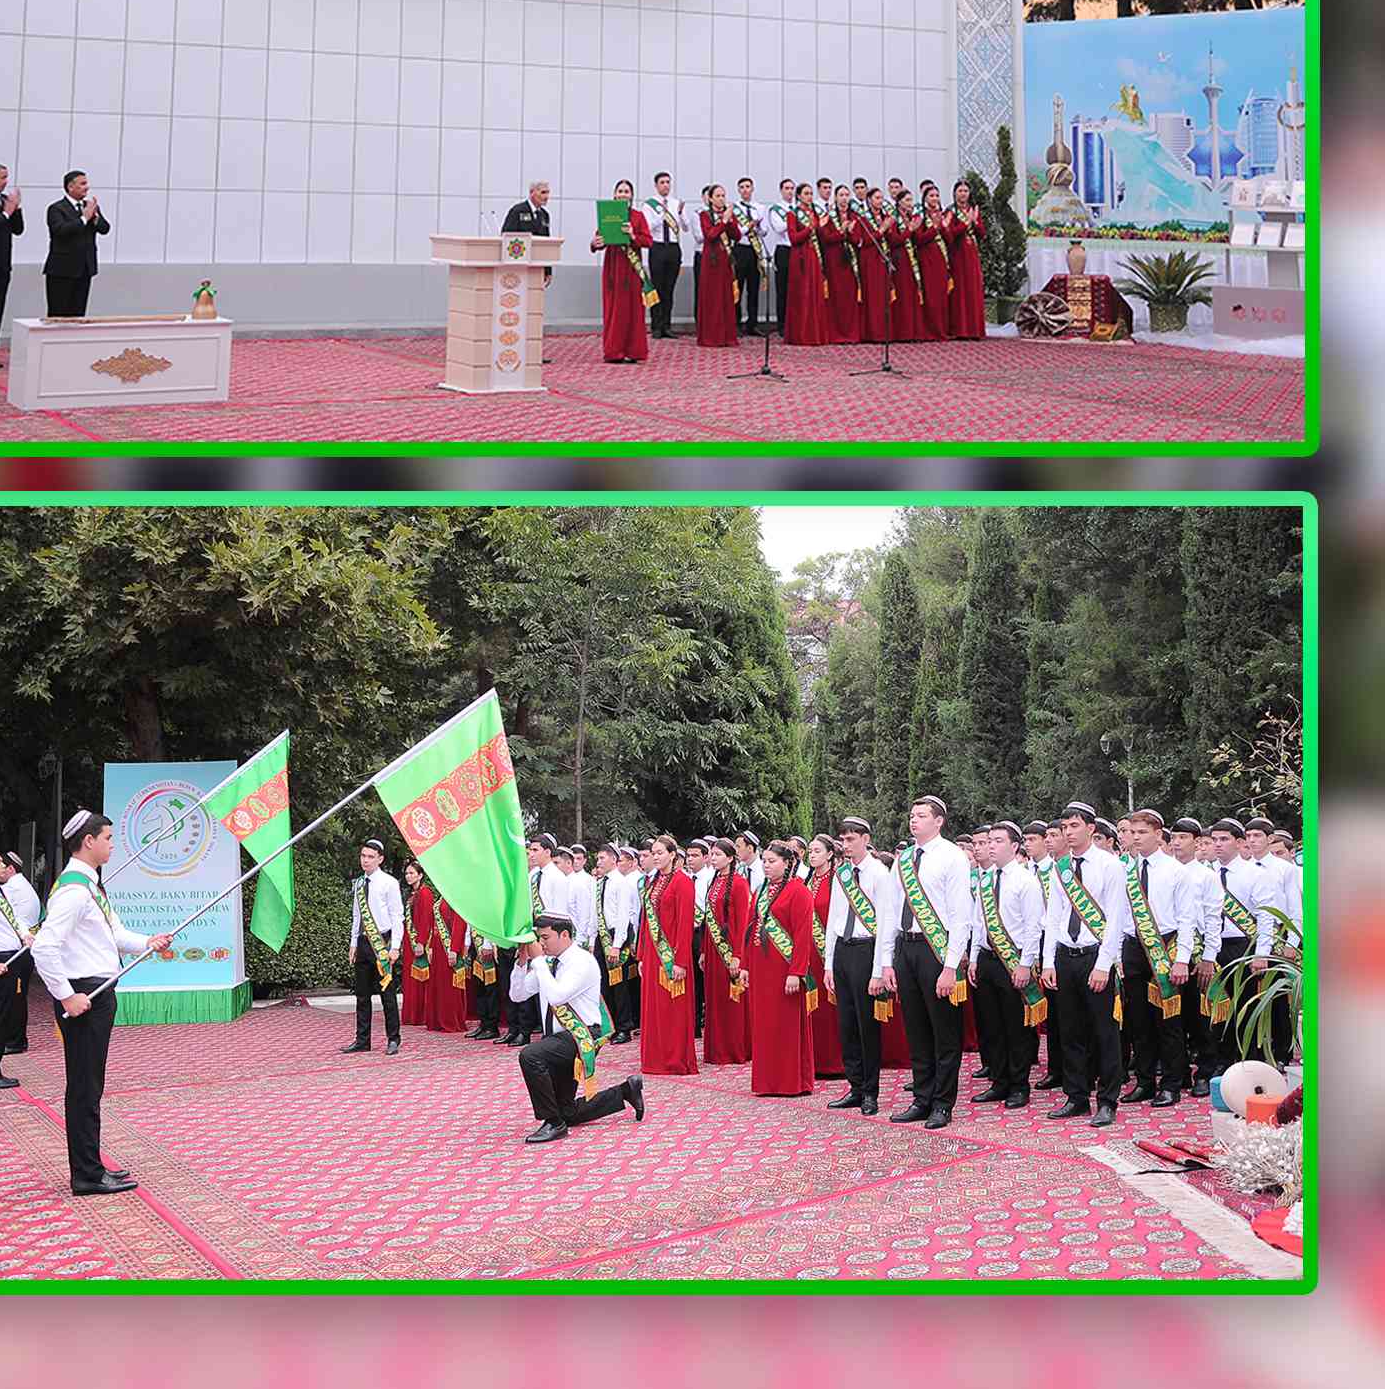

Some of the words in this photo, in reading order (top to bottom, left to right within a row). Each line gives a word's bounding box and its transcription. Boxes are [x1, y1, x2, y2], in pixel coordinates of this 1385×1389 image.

[846, 882, 875, 921] TALYP
[900, 861, 923, 903] TALYP
[914, 899, 942, 935] 2026
[981, 889, 1000, 929] TALYP
[1068, 879, 1102, 925] TALYP
[1125, 869, 1149, 914] TALYP
[364, 917, 382, 942] 2026
[768, 926, 794, 957] 2026
[990, 925, 1016, 959] 2026
[1136, 913, 1161, 947] 2026
[553, 1005, 576, 1030] 026
